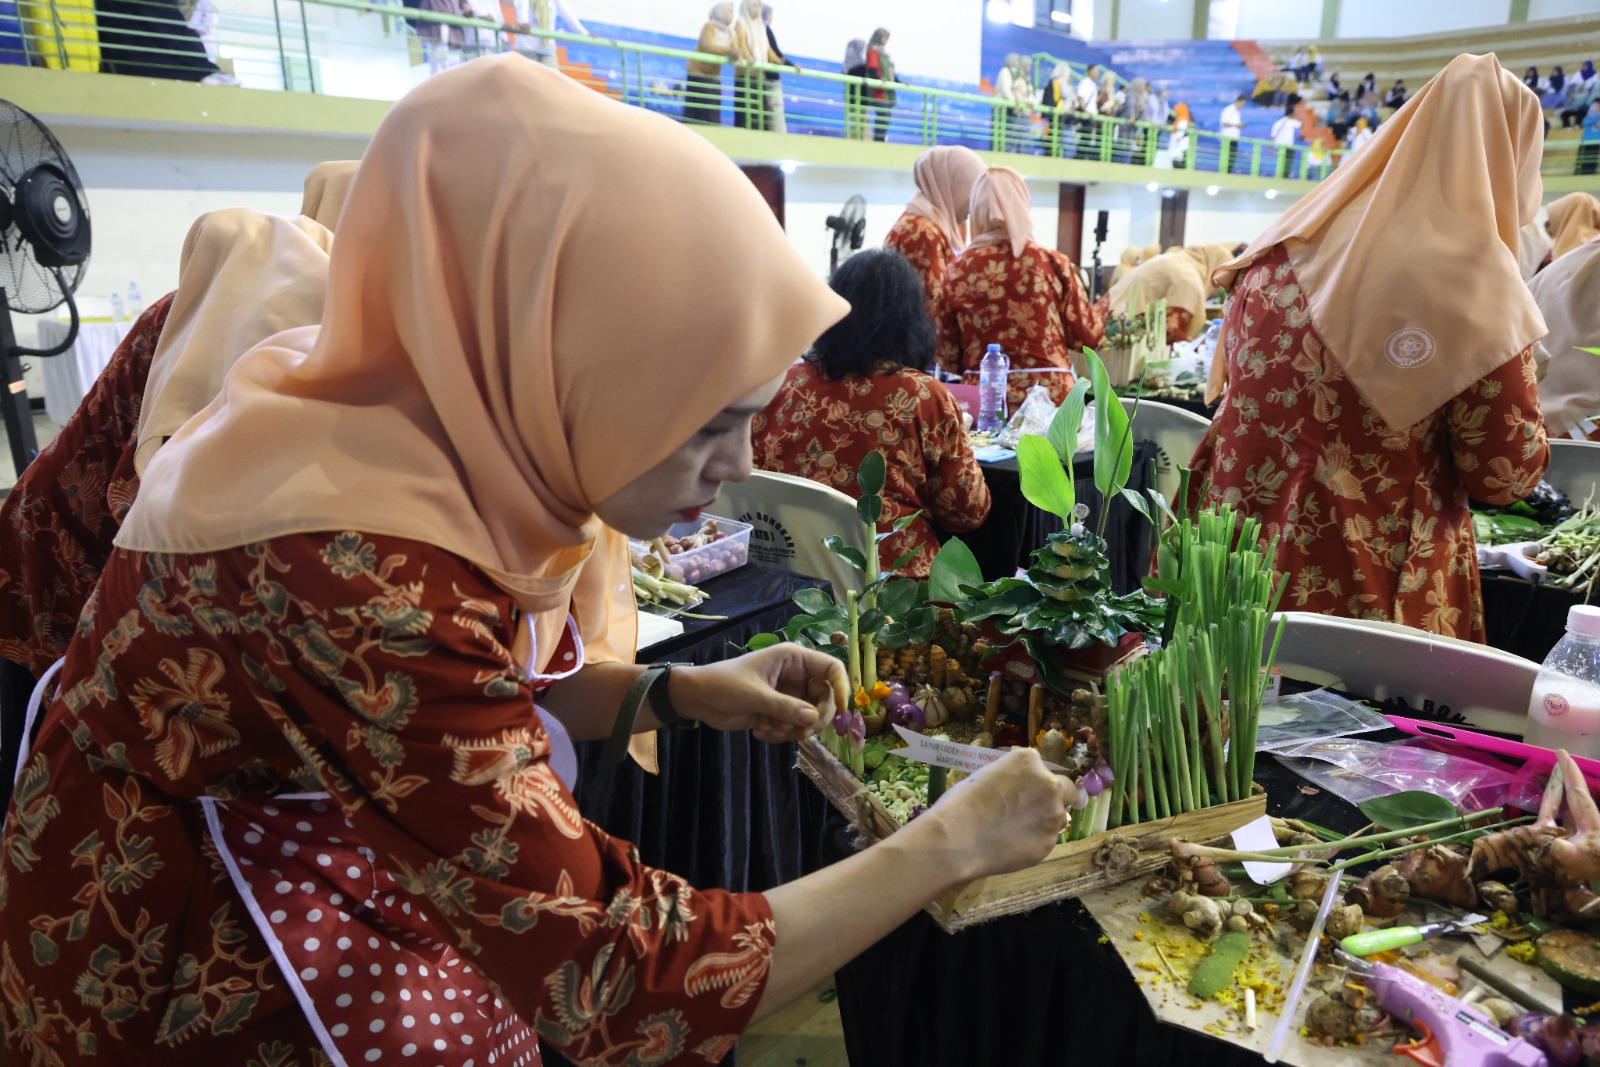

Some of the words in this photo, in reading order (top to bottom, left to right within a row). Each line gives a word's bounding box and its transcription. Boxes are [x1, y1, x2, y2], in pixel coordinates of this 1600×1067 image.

[756, 512, 795, 548] BONGKAR
[920, 740, 941, 752] SAYUR
[940, 745, 960, 757] LODEH
[960, 750, 977, 759] KHAS
